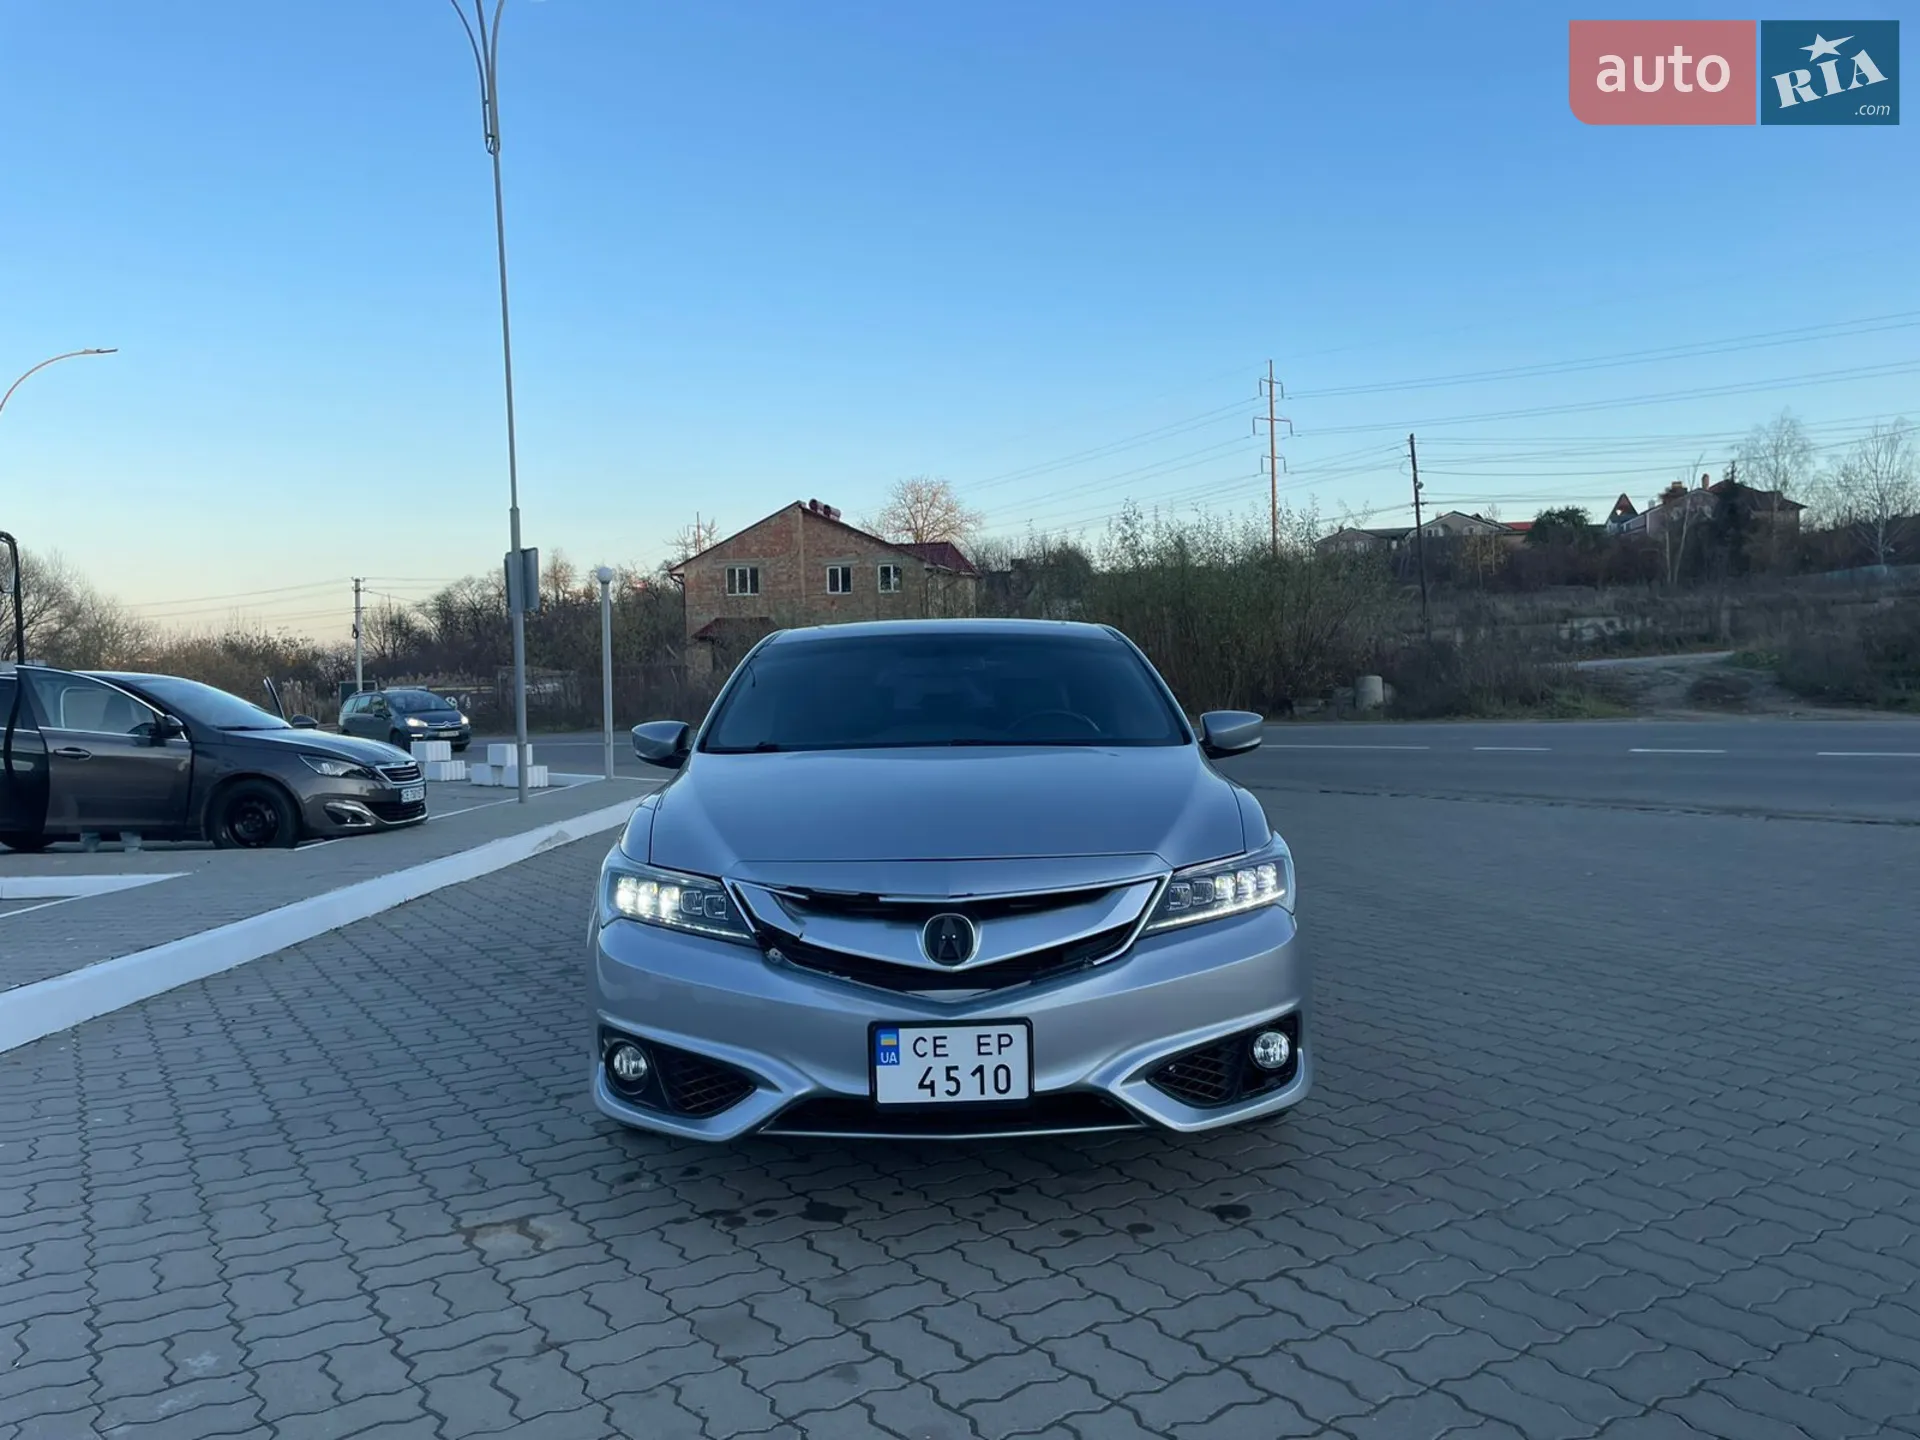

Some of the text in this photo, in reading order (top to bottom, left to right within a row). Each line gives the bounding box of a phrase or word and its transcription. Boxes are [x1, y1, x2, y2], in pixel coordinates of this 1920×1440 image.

[880, 1051, 898, 1064] UA
[912, 1033, 1013, 1058] CE EP
[918, 1063, 1011, 1097] 4510
